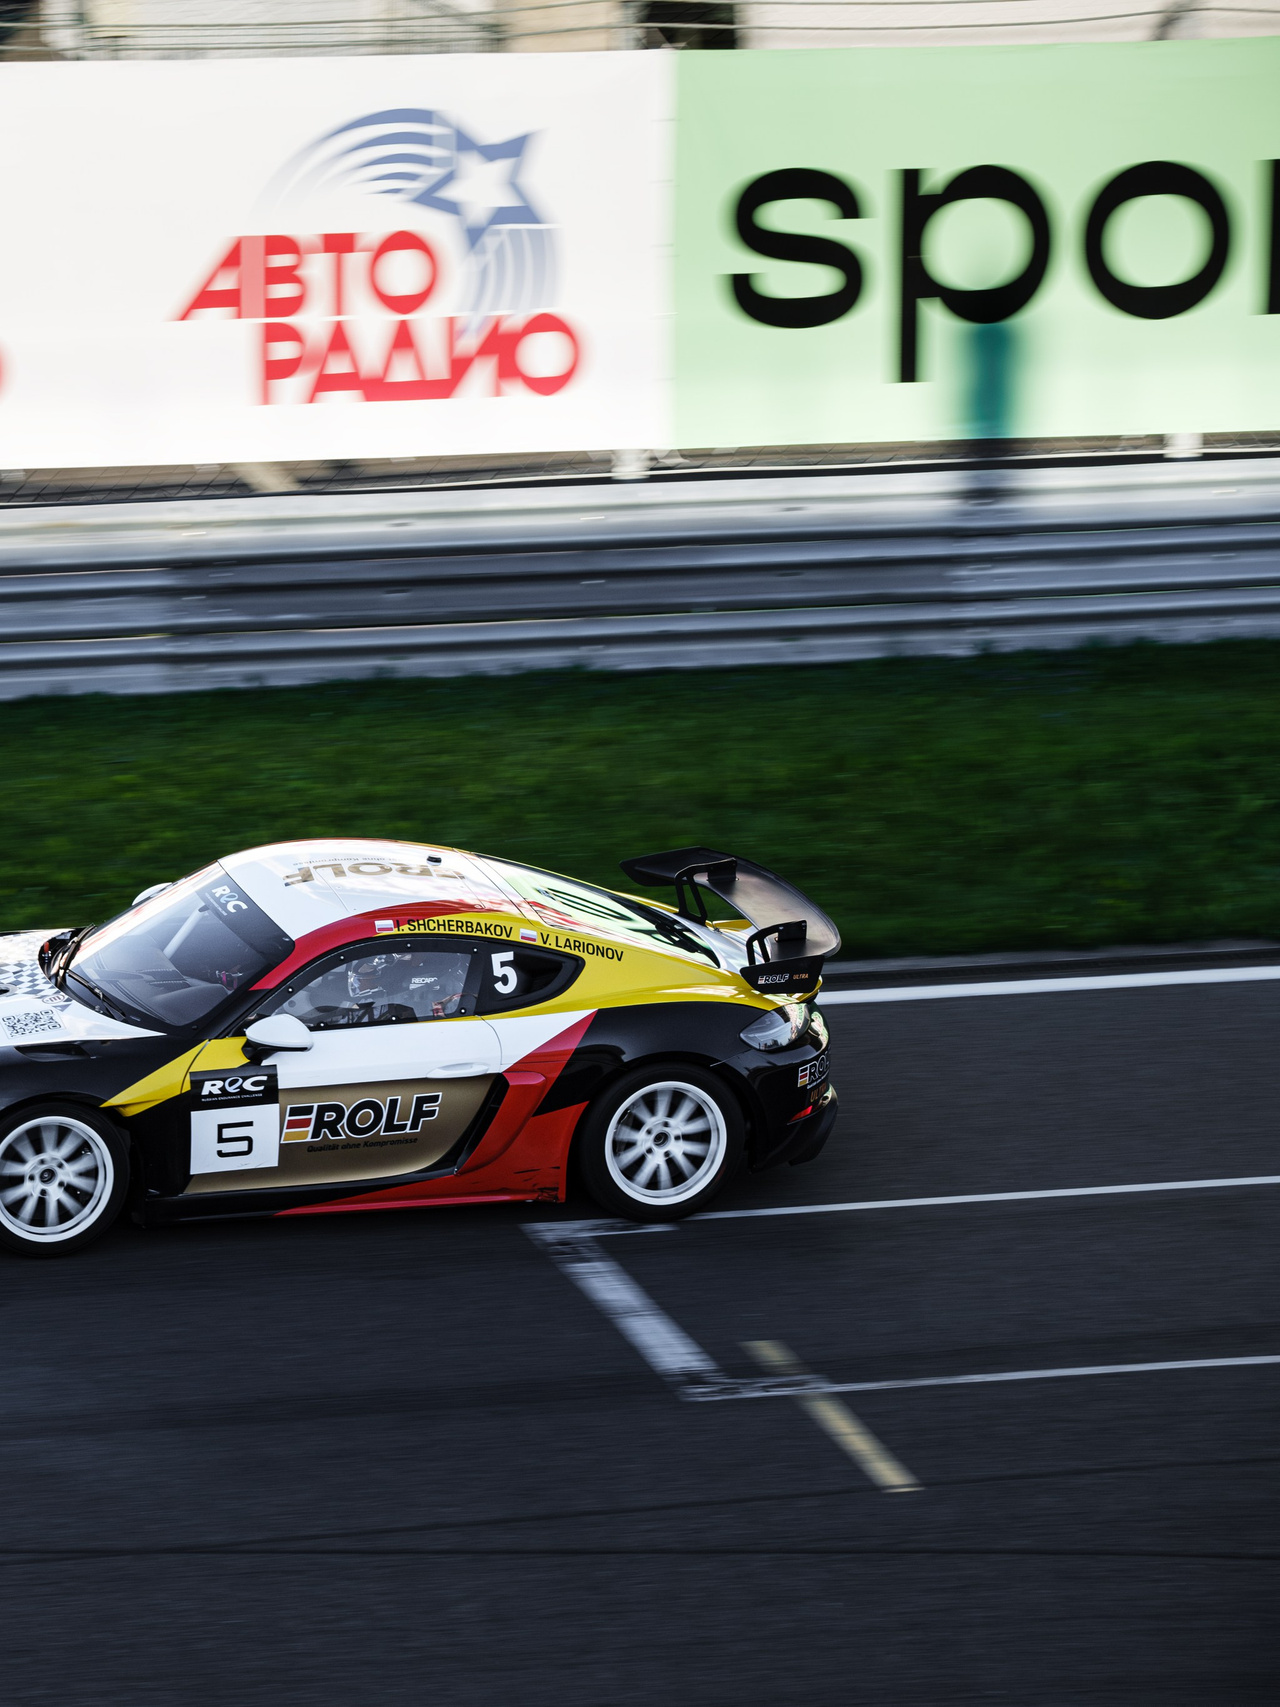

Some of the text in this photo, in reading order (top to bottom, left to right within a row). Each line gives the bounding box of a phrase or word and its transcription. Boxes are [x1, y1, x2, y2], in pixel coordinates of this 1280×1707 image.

[172, 230, 442, 321] АВТО
[257, 312, 582, 406] РАДИО
[283, 862, 433, 887] ROLF
[396, 918, 513, 938] I. SHCHERBAKOV
[540, 932, 624, 962] V. LARIONOV
[491, 951, 518, 994] 5
[764, 973, 789, 984] ROLF
[310, 1092, 442, 1140] ROLF
[217, 1121, 254, 1157] 5
[307, 1138, 418, 1153] Qualität ohne Kompromisse
